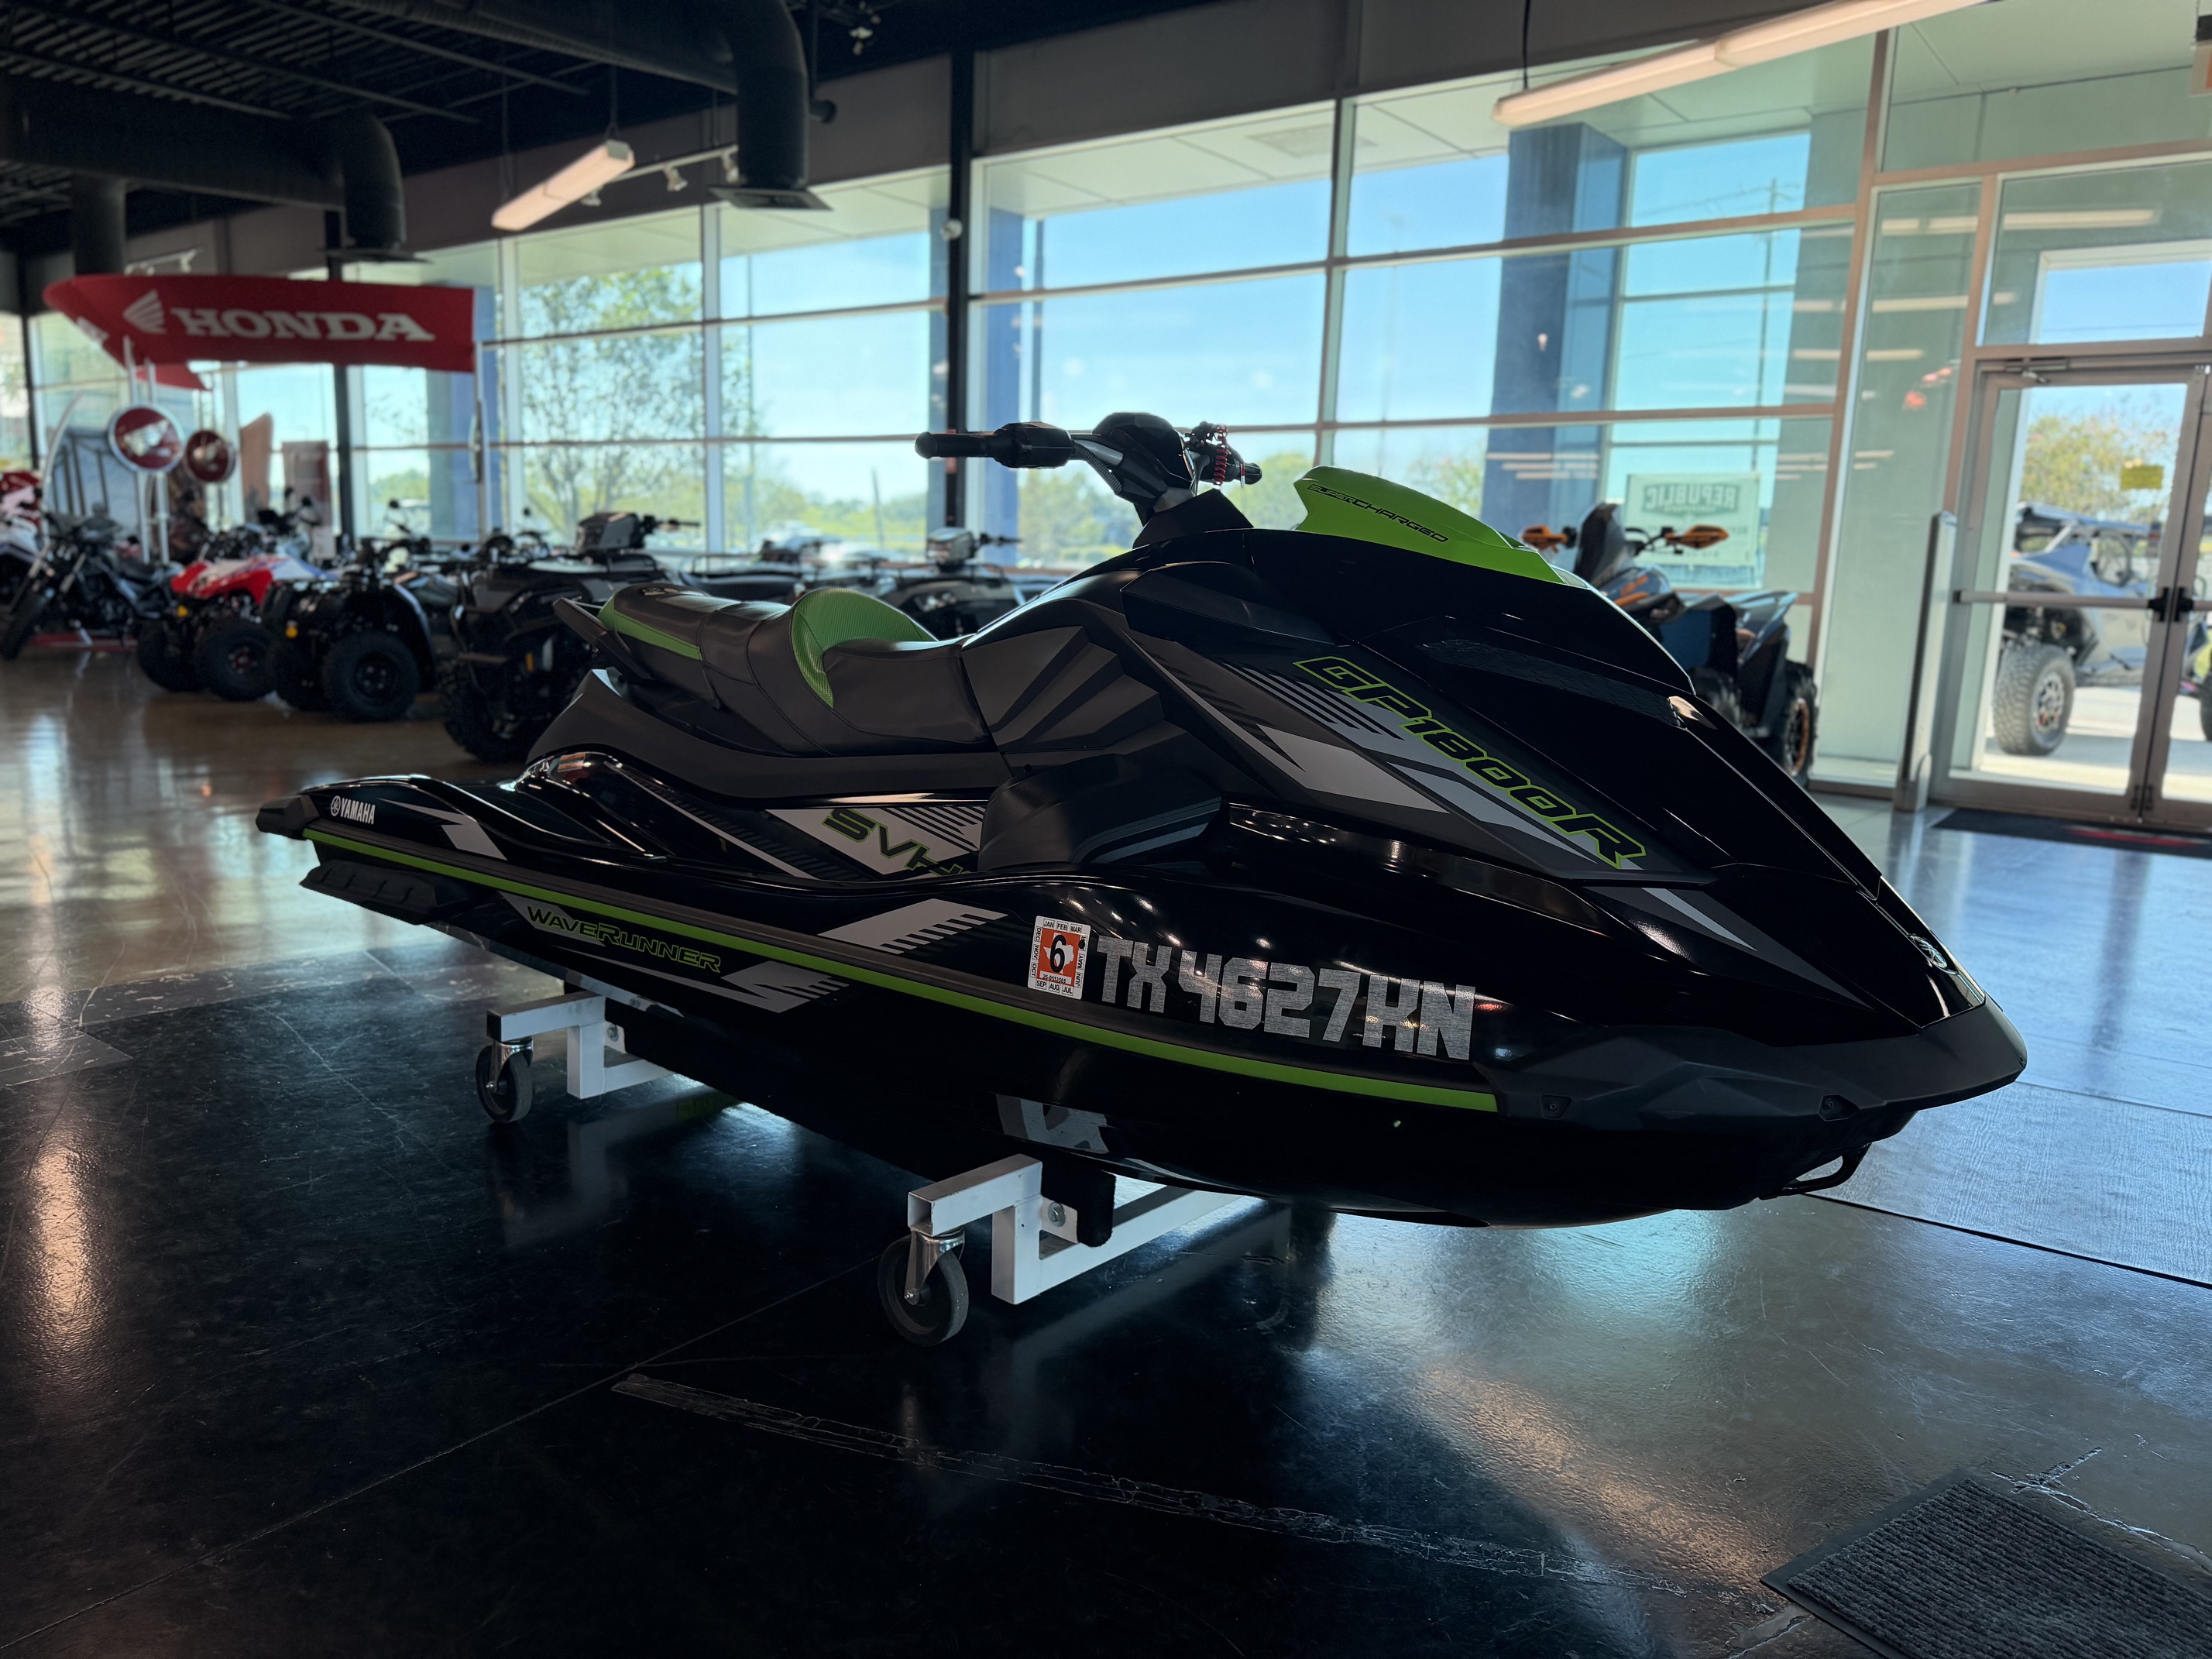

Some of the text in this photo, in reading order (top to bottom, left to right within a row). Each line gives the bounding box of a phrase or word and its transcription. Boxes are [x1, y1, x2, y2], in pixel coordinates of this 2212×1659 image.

[170, 308, 435, 341] HONDA
[1307, 484, 1449, 543] SUPERCHARGED
[1293, 656, 1647, 870] GP1800R
[341, 798, 376, 825] YAMAHA
[822, 808, 971, 877] SVH
[1043, 920, 1054, 929] JAN
[1050, 934, 1067, 973] 6
[1049, 983, 1060, 991] AUG
